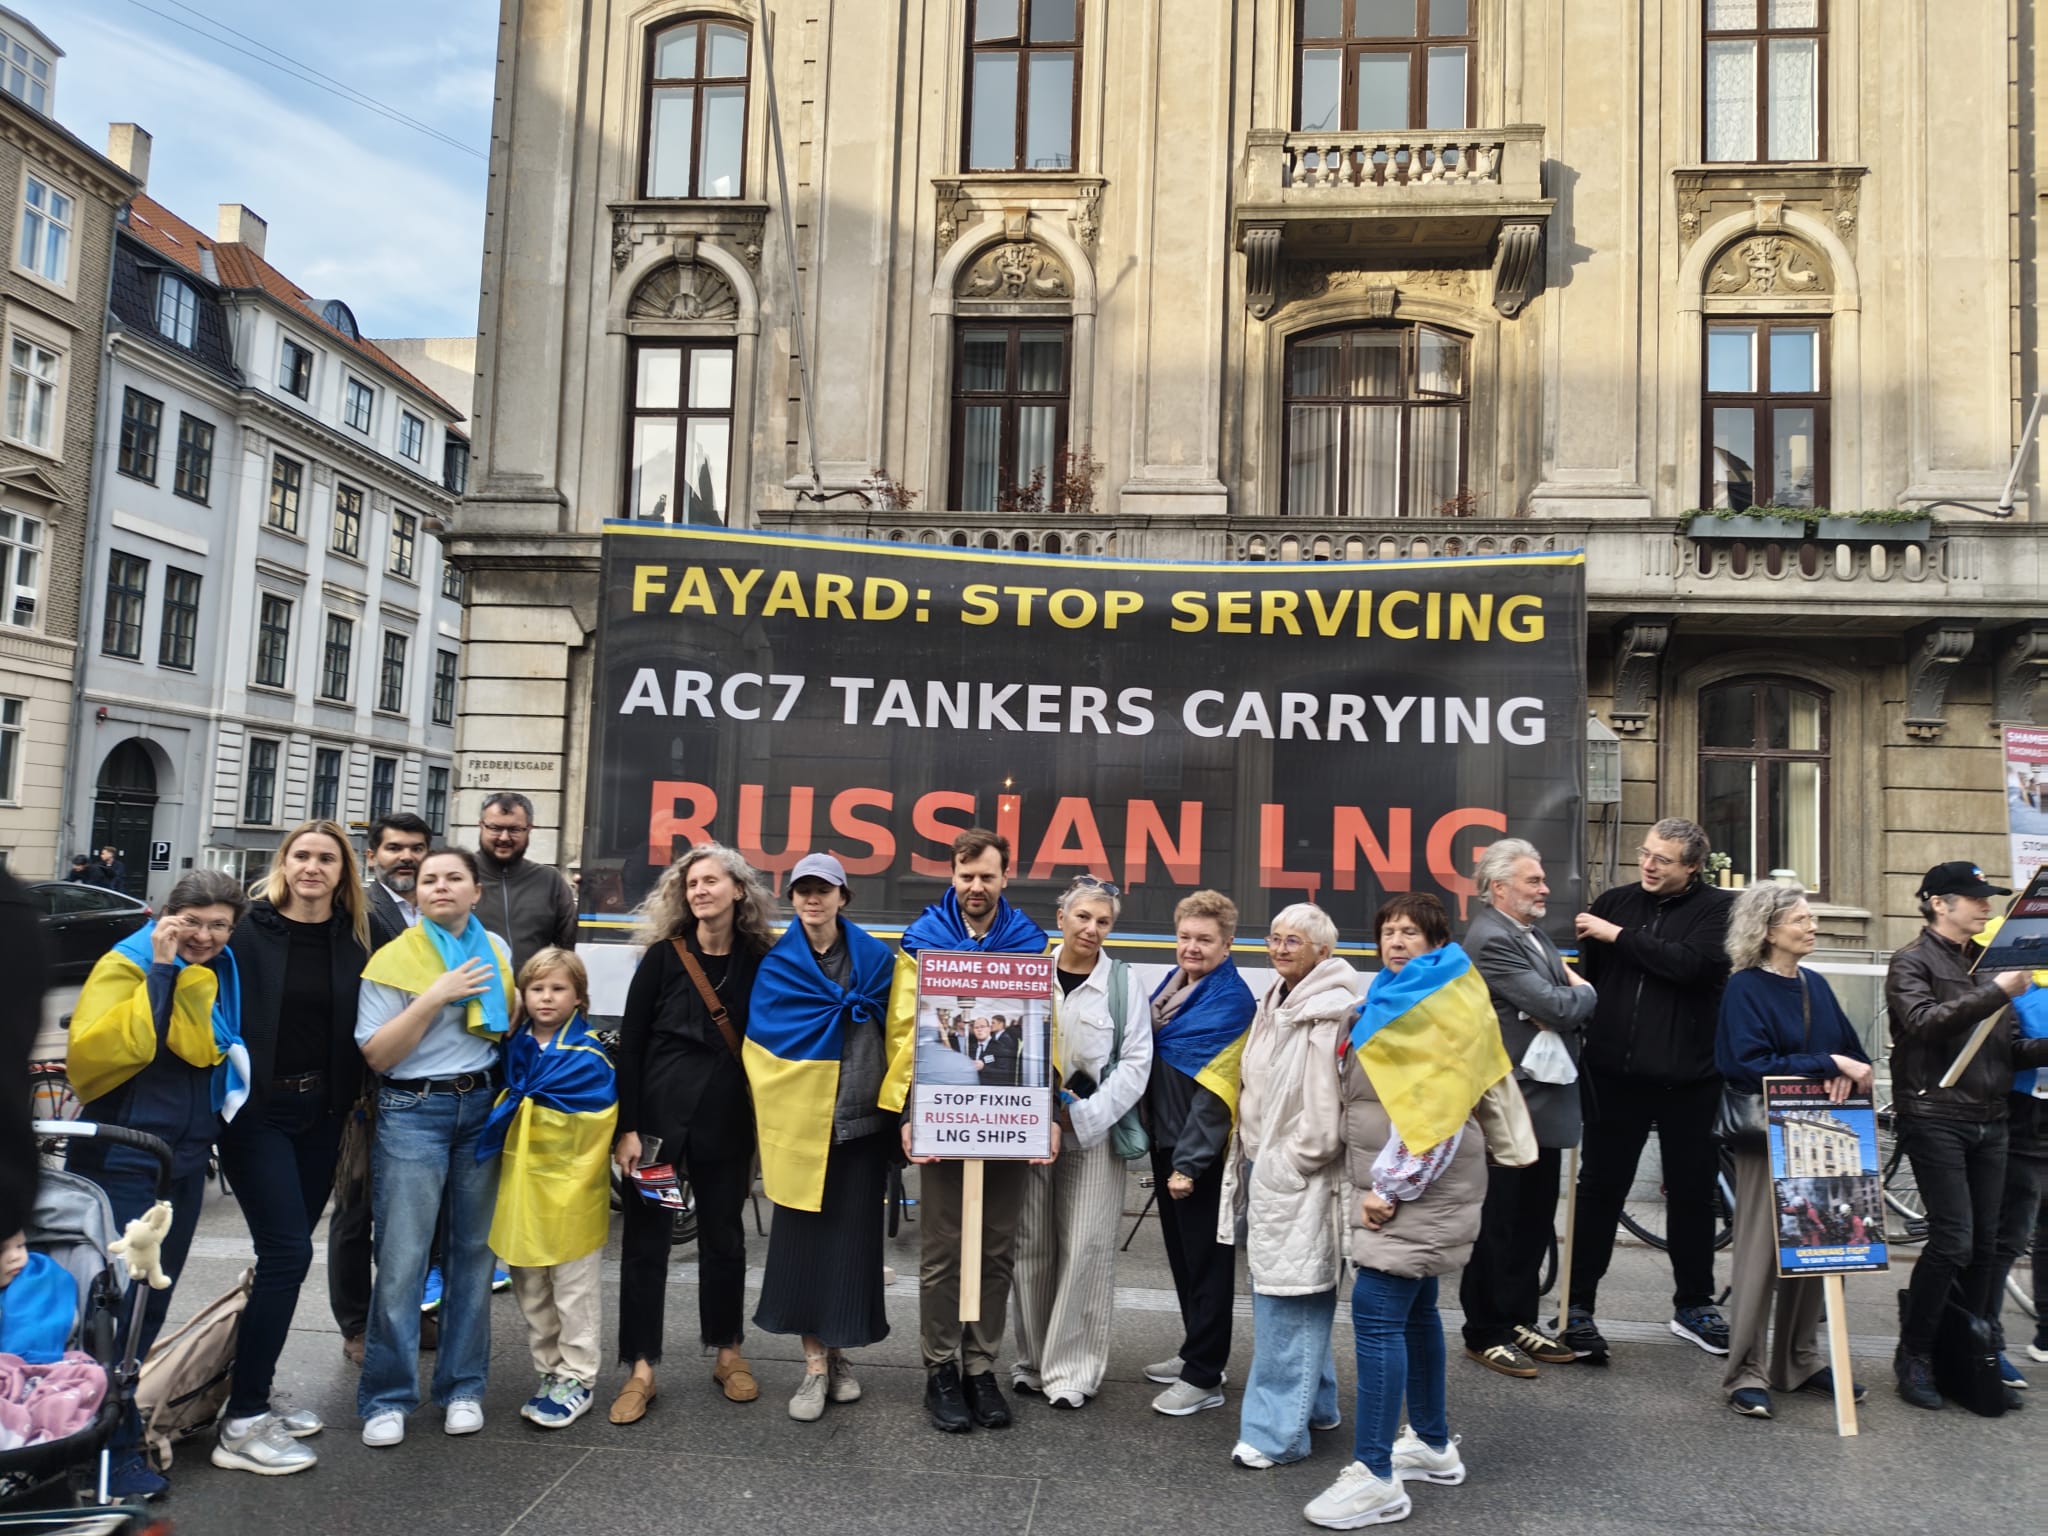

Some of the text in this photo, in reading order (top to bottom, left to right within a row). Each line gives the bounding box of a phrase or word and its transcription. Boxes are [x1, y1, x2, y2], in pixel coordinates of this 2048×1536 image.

[632, 565, 1545, 643] FAYARD: STOP SERVICING
[619, 667, 1546, 746] ARC7 TANKERS CARRYING
[468, 759, 555, 771] FREDERIKSGADE
[648, 780, 1507, 898] RUSSIAN LNG
[155, 842, 168, 860] P
[925, 958, 1048, 977] SHAME ON YOU
[925, 977, 1048, 992] THOMAS ANDERSEN
[1769, 1085, 1777, 1094] A
[934, 1093, 1032, 1107] STOP FIXING
[925, 1112, 1039, 1125] RUSSIA-LINKED
[936, 1129, 1027, 1143] LNG SHIPS
